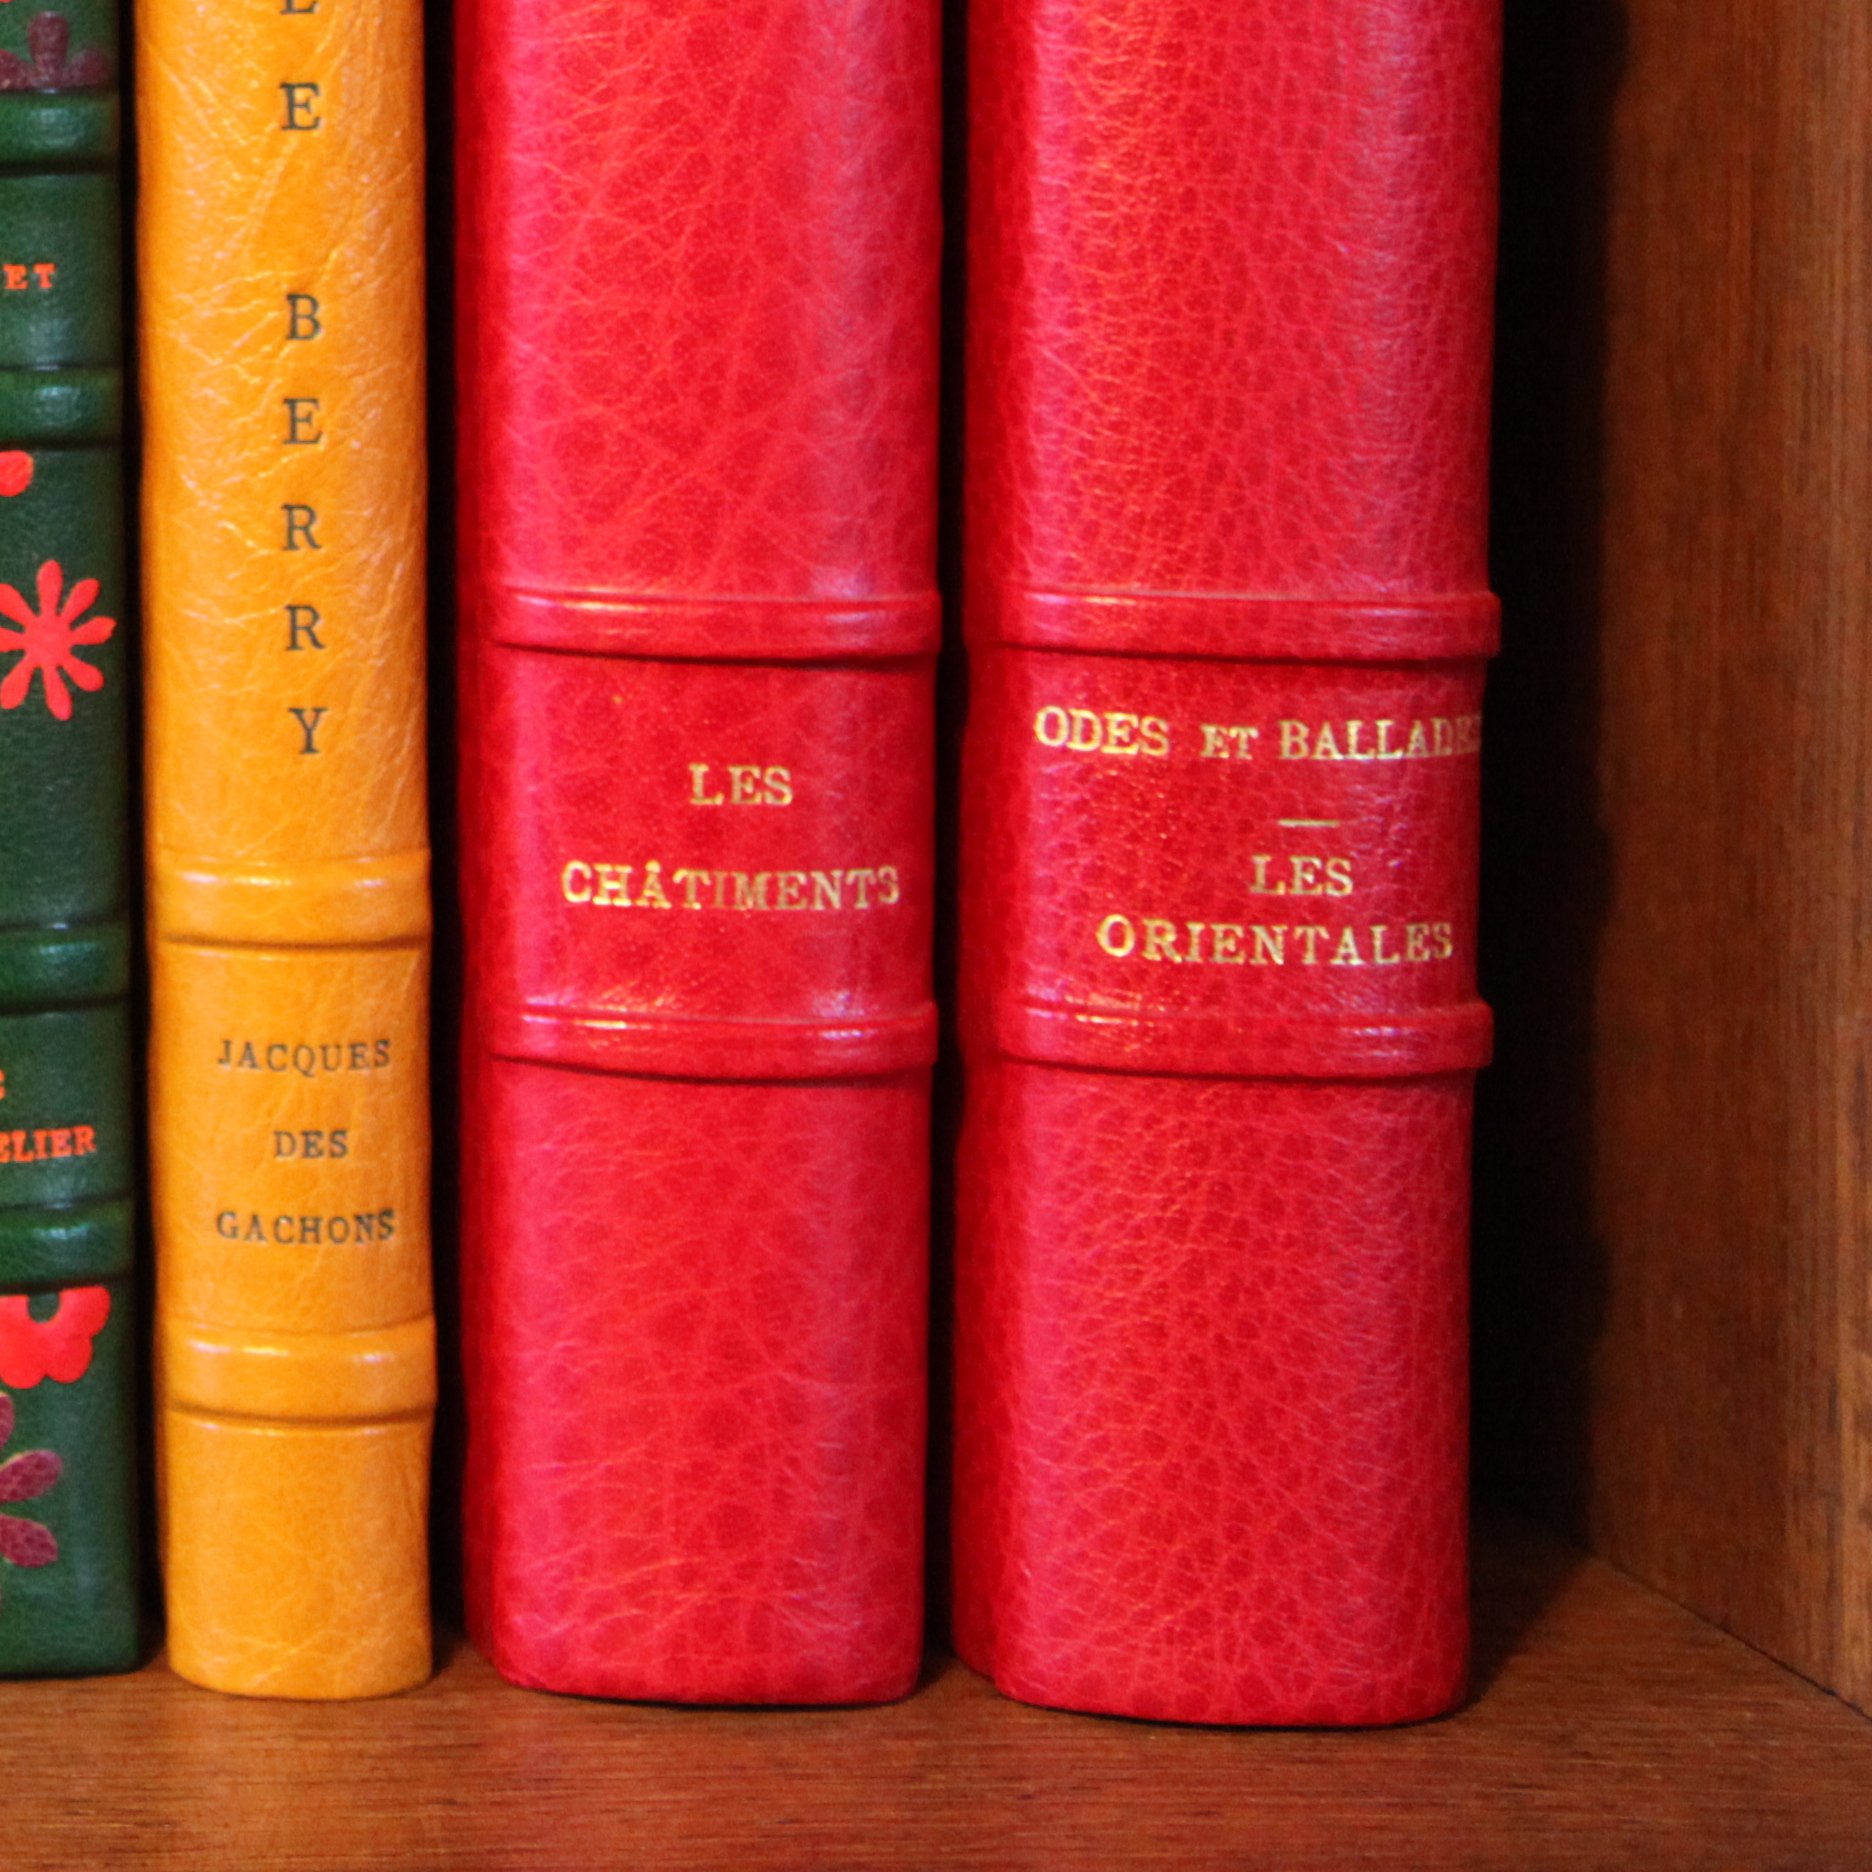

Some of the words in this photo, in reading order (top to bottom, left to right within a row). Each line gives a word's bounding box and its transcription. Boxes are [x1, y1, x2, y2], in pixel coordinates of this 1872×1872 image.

[280, 293, 329, 755] BERRY
[1033, 705, 1170, 757] ODES
[1199, 725, 1259, 760] ET
[1276, 714, 1482, 760] BALLADE
[688, 762, 793, 808] LES
[559, 859, 900, 912] CHÂTIMENTS
[1249, 854, 1354, 898] LES
[1096, 913, 1454, 966] ORIENTALES
[217, 1039, 392, 1078] JACQUES
[274, 1129, 349, 1160] DES
[215, 1208, 397, 1246] GACHONS
